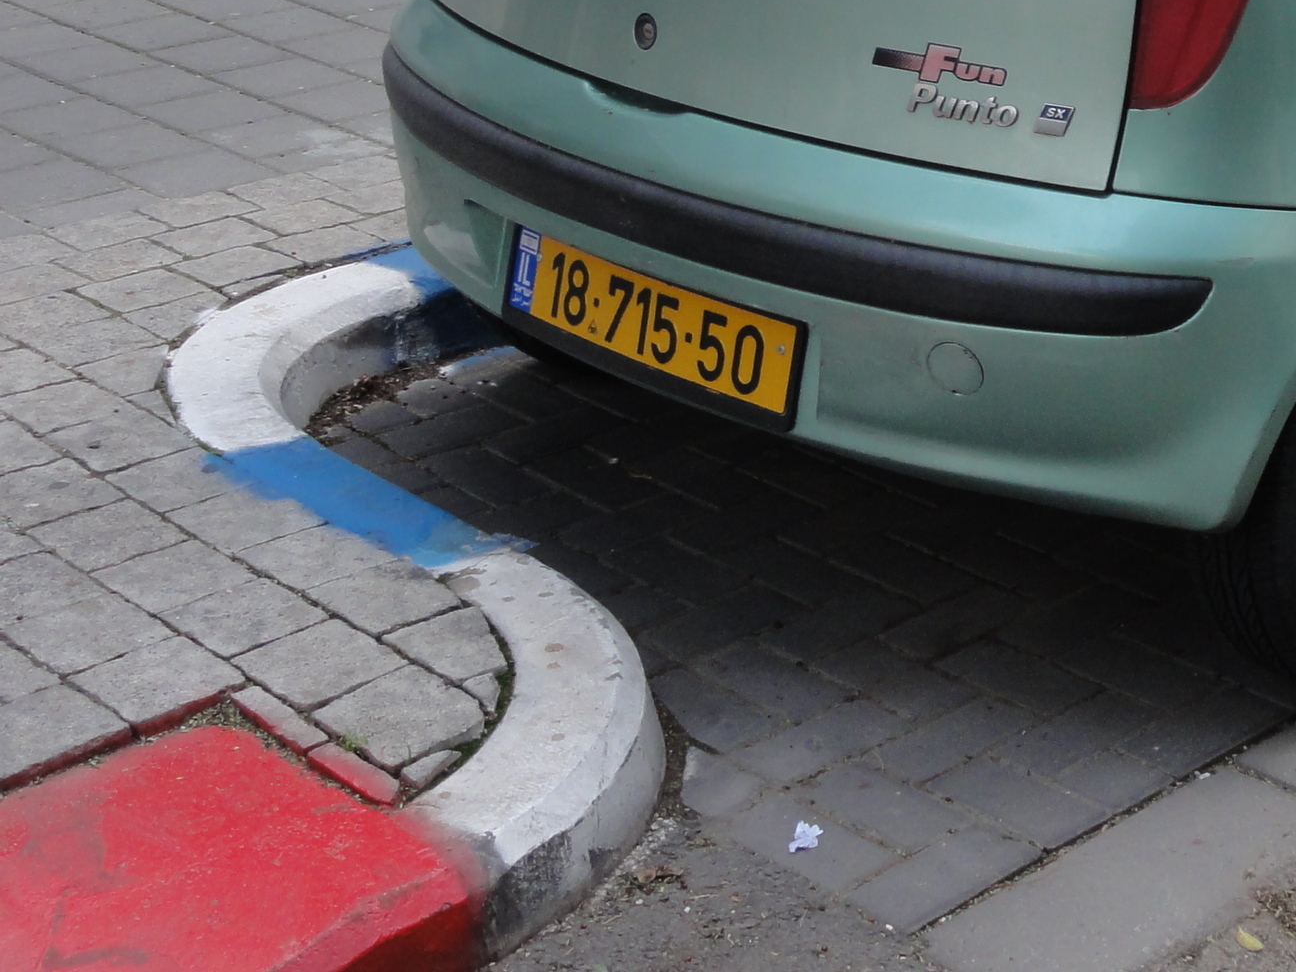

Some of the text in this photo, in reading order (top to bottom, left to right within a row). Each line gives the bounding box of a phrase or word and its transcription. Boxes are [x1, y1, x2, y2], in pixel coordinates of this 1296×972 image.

[919, 42, 1007, 86] Fun
[906, 83, 1067, 127] Punto SX
